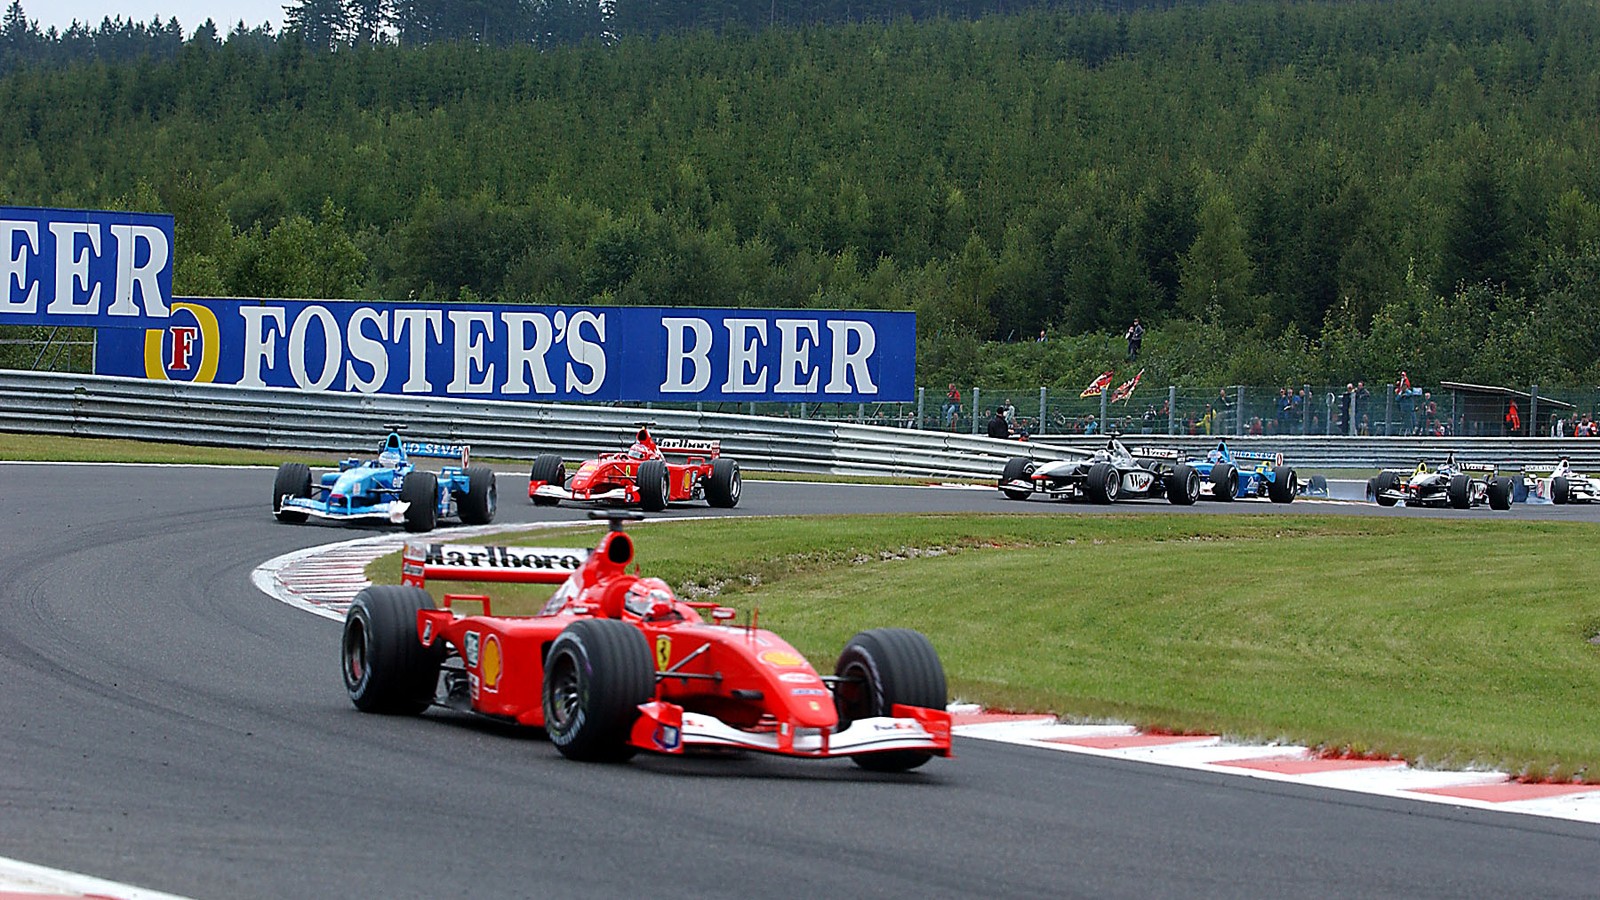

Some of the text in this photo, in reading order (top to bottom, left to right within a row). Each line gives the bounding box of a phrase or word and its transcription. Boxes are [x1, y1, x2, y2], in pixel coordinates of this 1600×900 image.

[168, 327, 198, 371] F
[237, 305, 879, 395] FOSTER'S BEER
[425, 543, 581, 570] Marlboro
